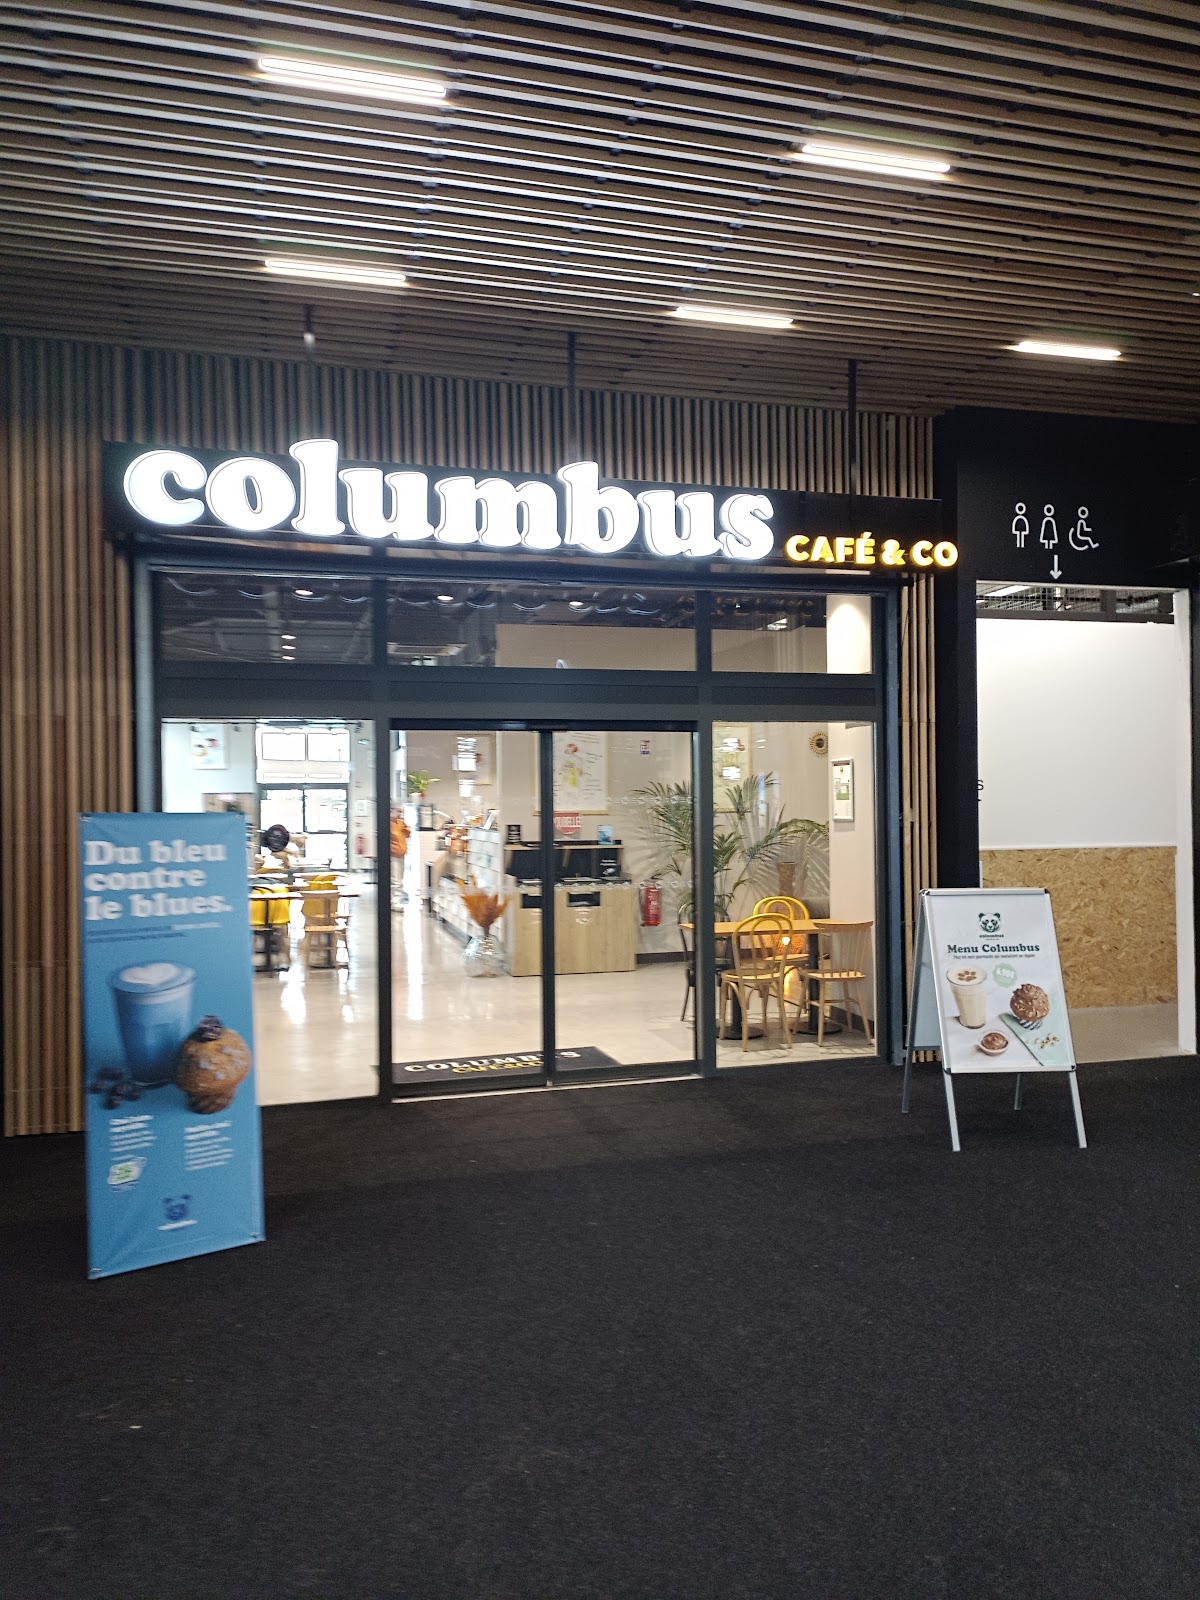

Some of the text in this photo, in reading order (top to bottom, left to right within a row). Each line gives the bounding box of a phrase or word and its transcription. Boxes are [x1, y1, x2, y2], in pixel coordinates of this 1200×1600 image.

[122, 438, 776, 561] columbus
[785, 530, 959, 567] CAFÉ & CO
[83, 839, 227, 866] Du bleu
[84, 866, 207, 892] contre
[84, 892, 234, 921] le blues.
[947, 943, 1040, 954] Menu Columbus
[403, 1051, 581, 1072] COLUMBS
